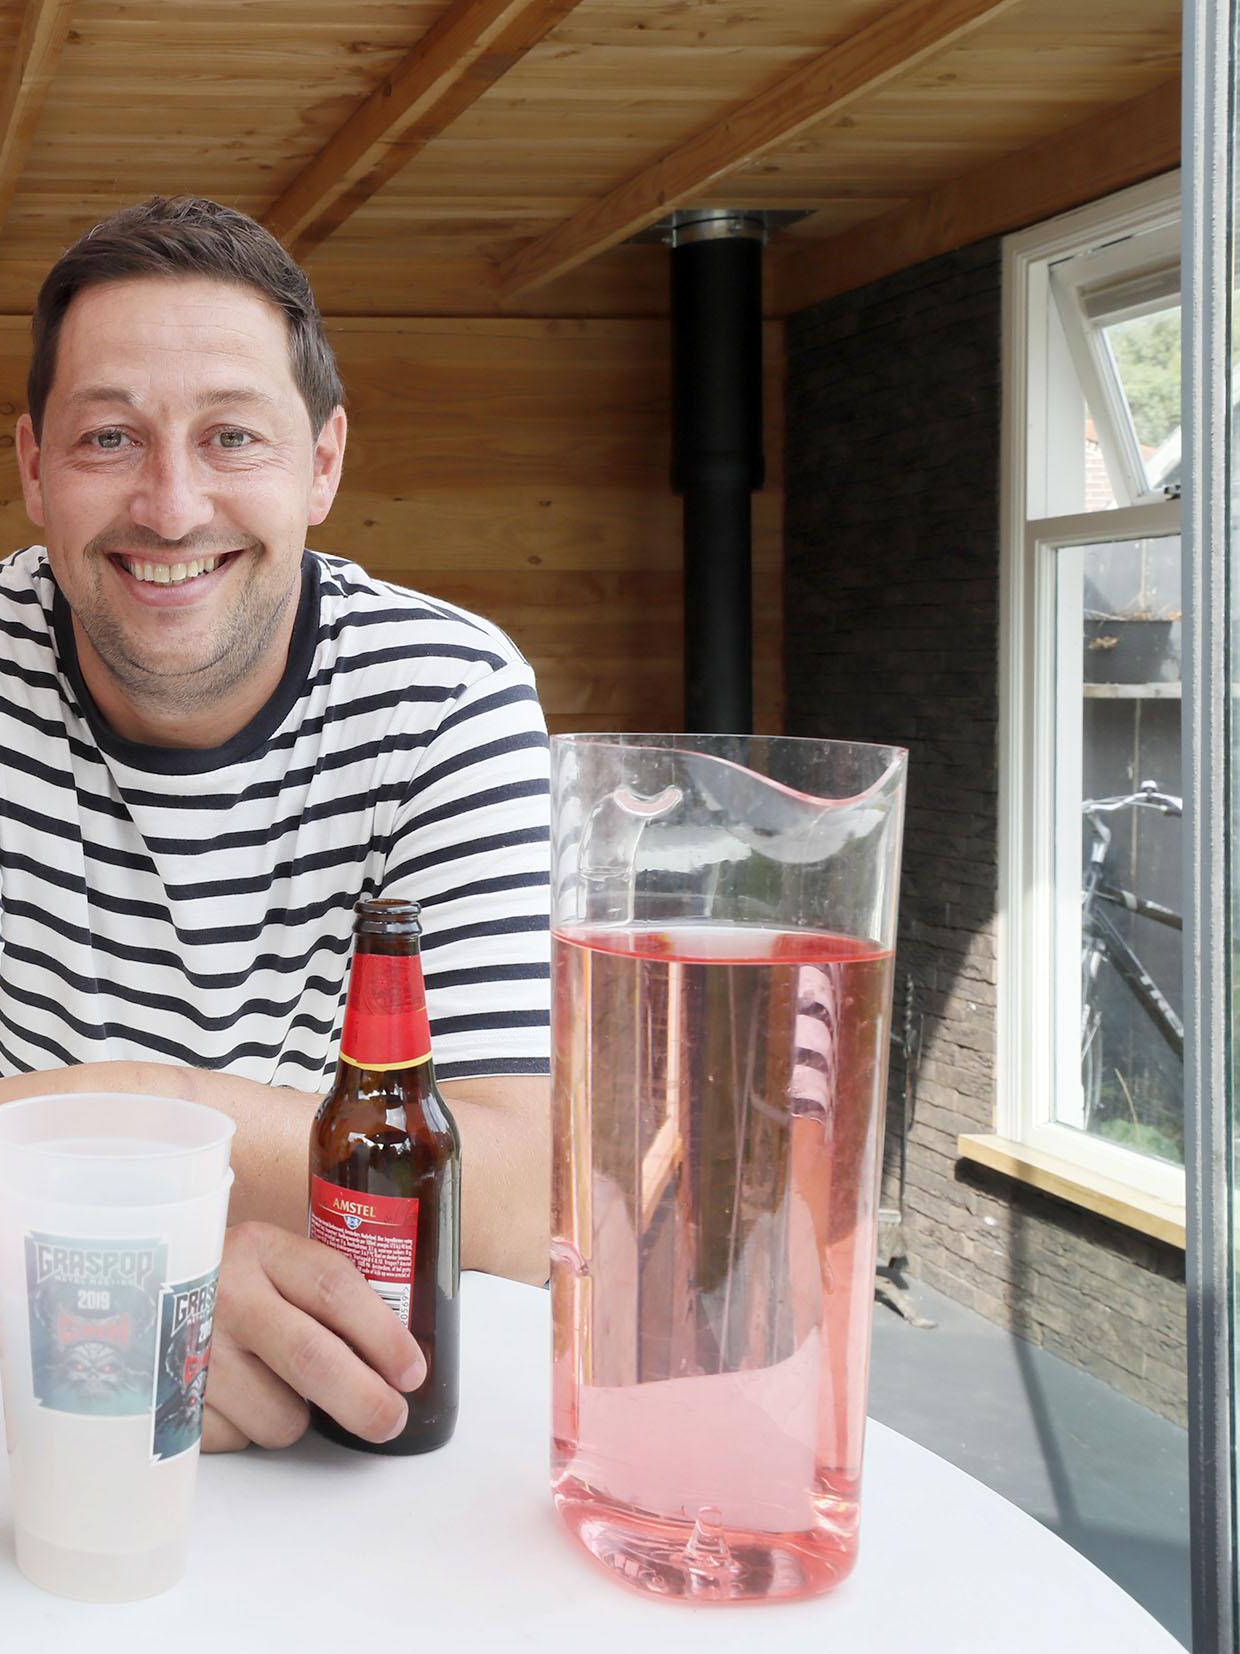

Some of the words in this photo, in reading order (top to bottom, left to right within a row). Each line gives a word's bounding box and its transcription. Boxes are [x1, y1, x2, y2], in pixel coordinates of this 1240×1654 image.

[332, 1198, 377, 1218] AMSTEL
[34, 1243, 154, 1291] GRASPOP
[76, 1289, 111, 1311] 2019
